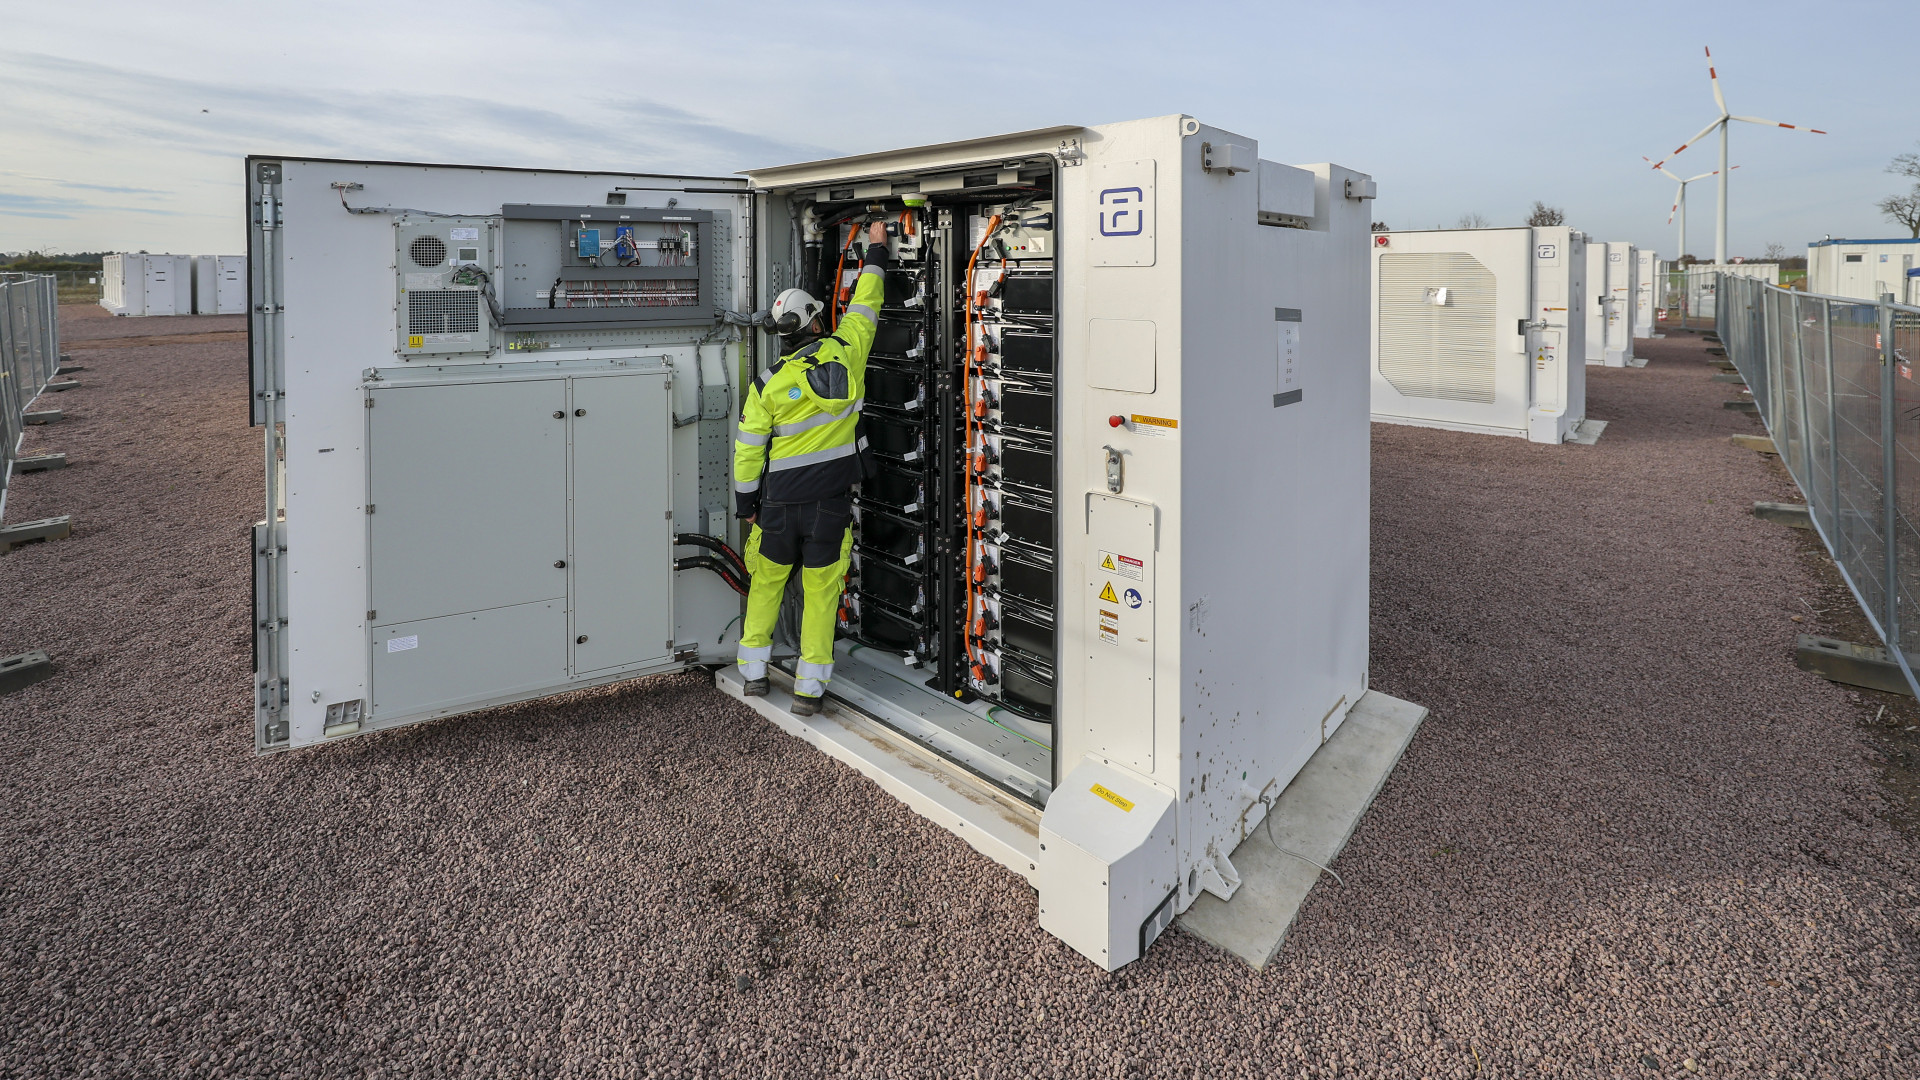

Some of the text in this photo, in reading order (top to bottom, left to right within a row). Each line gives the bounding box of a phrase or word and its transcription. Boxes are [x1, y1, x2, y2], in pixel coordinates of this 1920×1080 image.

[1143, 417, 1172, 426] WARNING
[1096, 787, 1127, 807] Do Not Step
